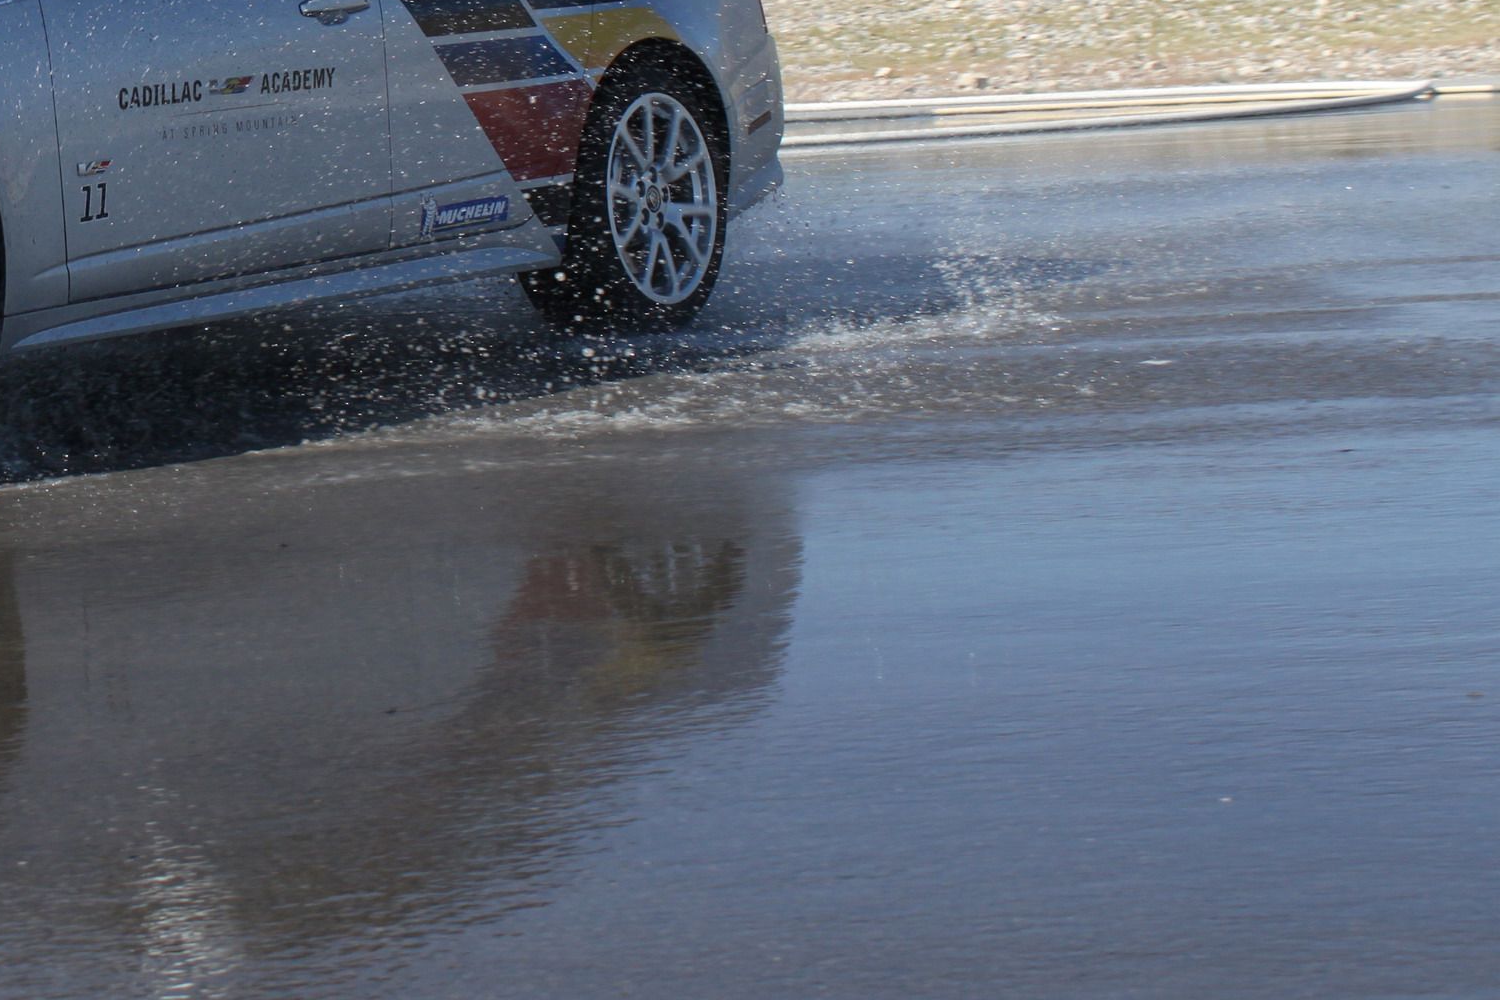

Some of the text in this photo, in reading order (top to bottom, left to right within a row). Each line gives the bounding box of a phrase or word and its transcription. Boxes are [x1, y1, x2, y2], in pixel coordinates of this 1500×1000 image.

[118, 67, 336, 110] CADILLAC ACADEMY
[80, 182, 109, 223] 11
[438, 200, 506, 225] MICHELIN
